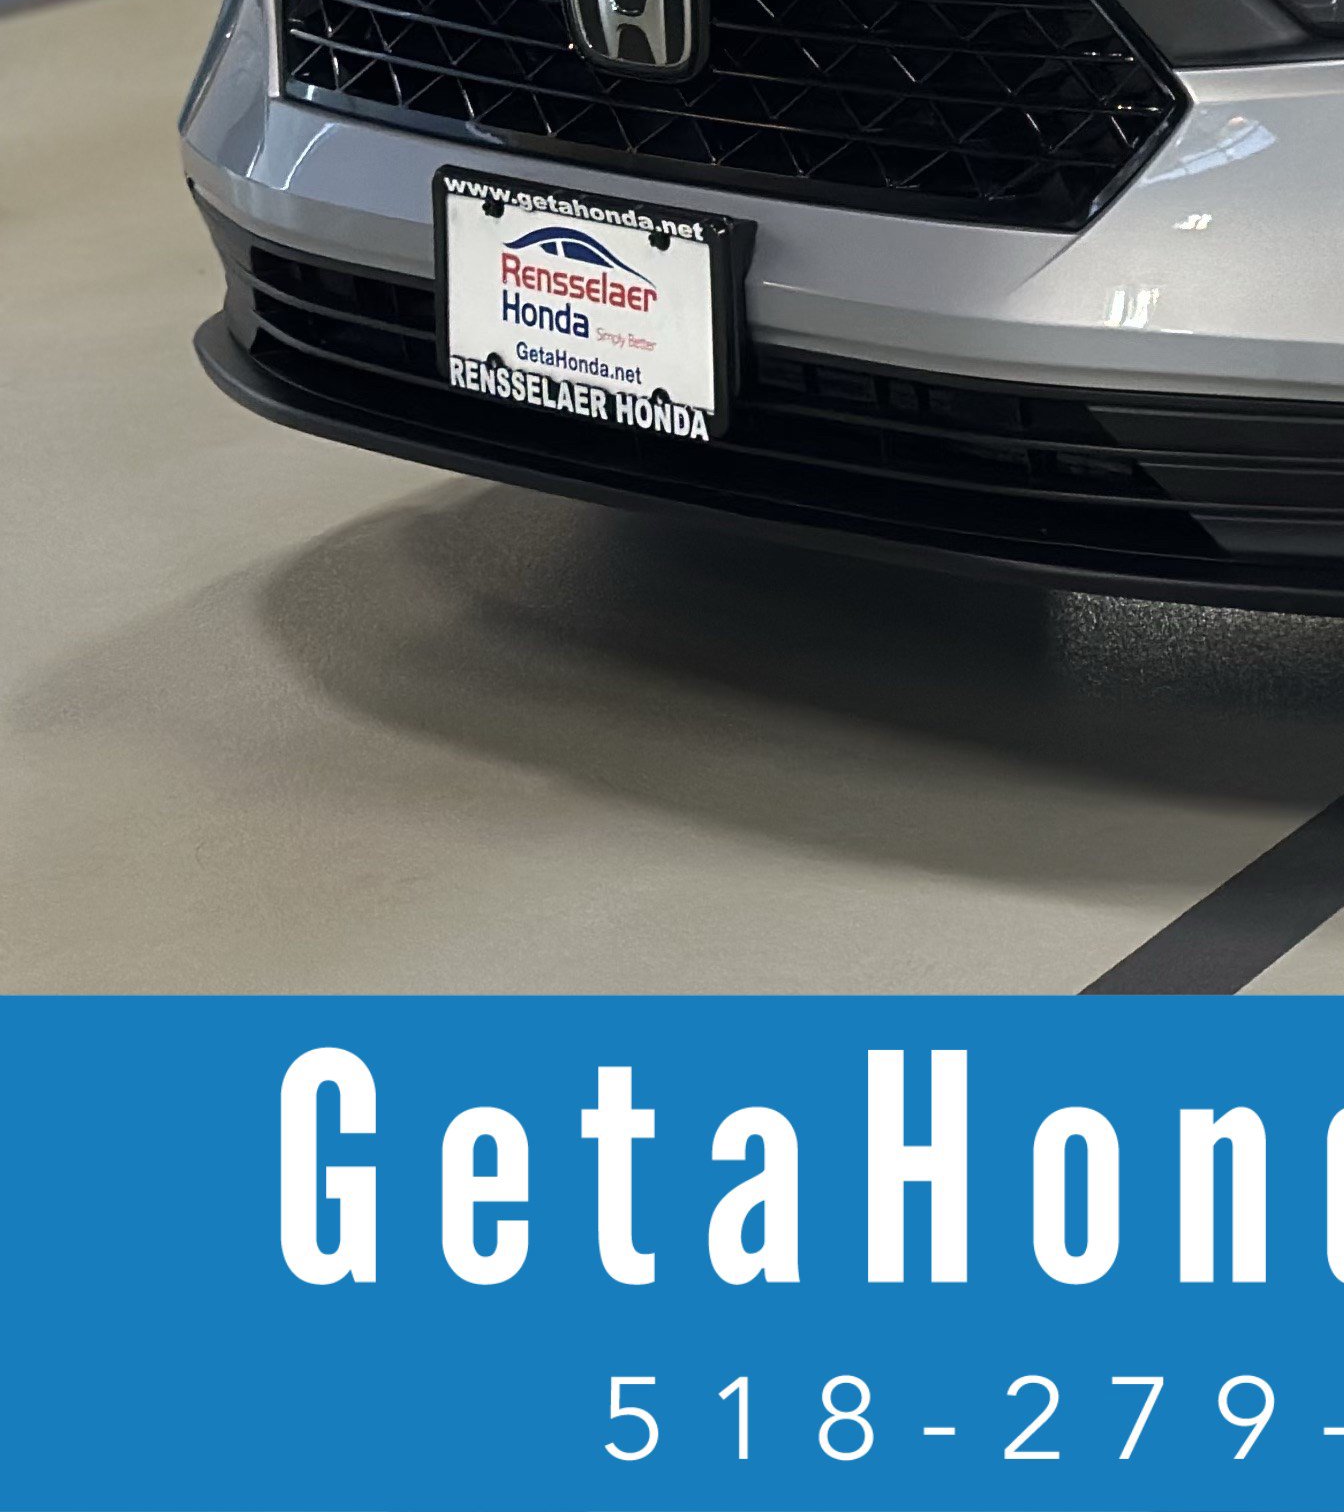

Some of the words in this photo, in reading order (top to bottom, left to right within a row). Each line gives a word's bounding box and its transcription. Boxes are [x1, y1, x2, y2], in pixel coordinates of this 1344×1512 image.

[444, 176, 704, 241] www.getahonda.net
[501, 252, 657, 312] Rensselaer
[503, 290, 589, 338] Honda
[516, 341, 642, 385] GetaHonda.net
[450, 355, 608, 420] RENSSELAER
[616, 394, 710, 441] HONDA
